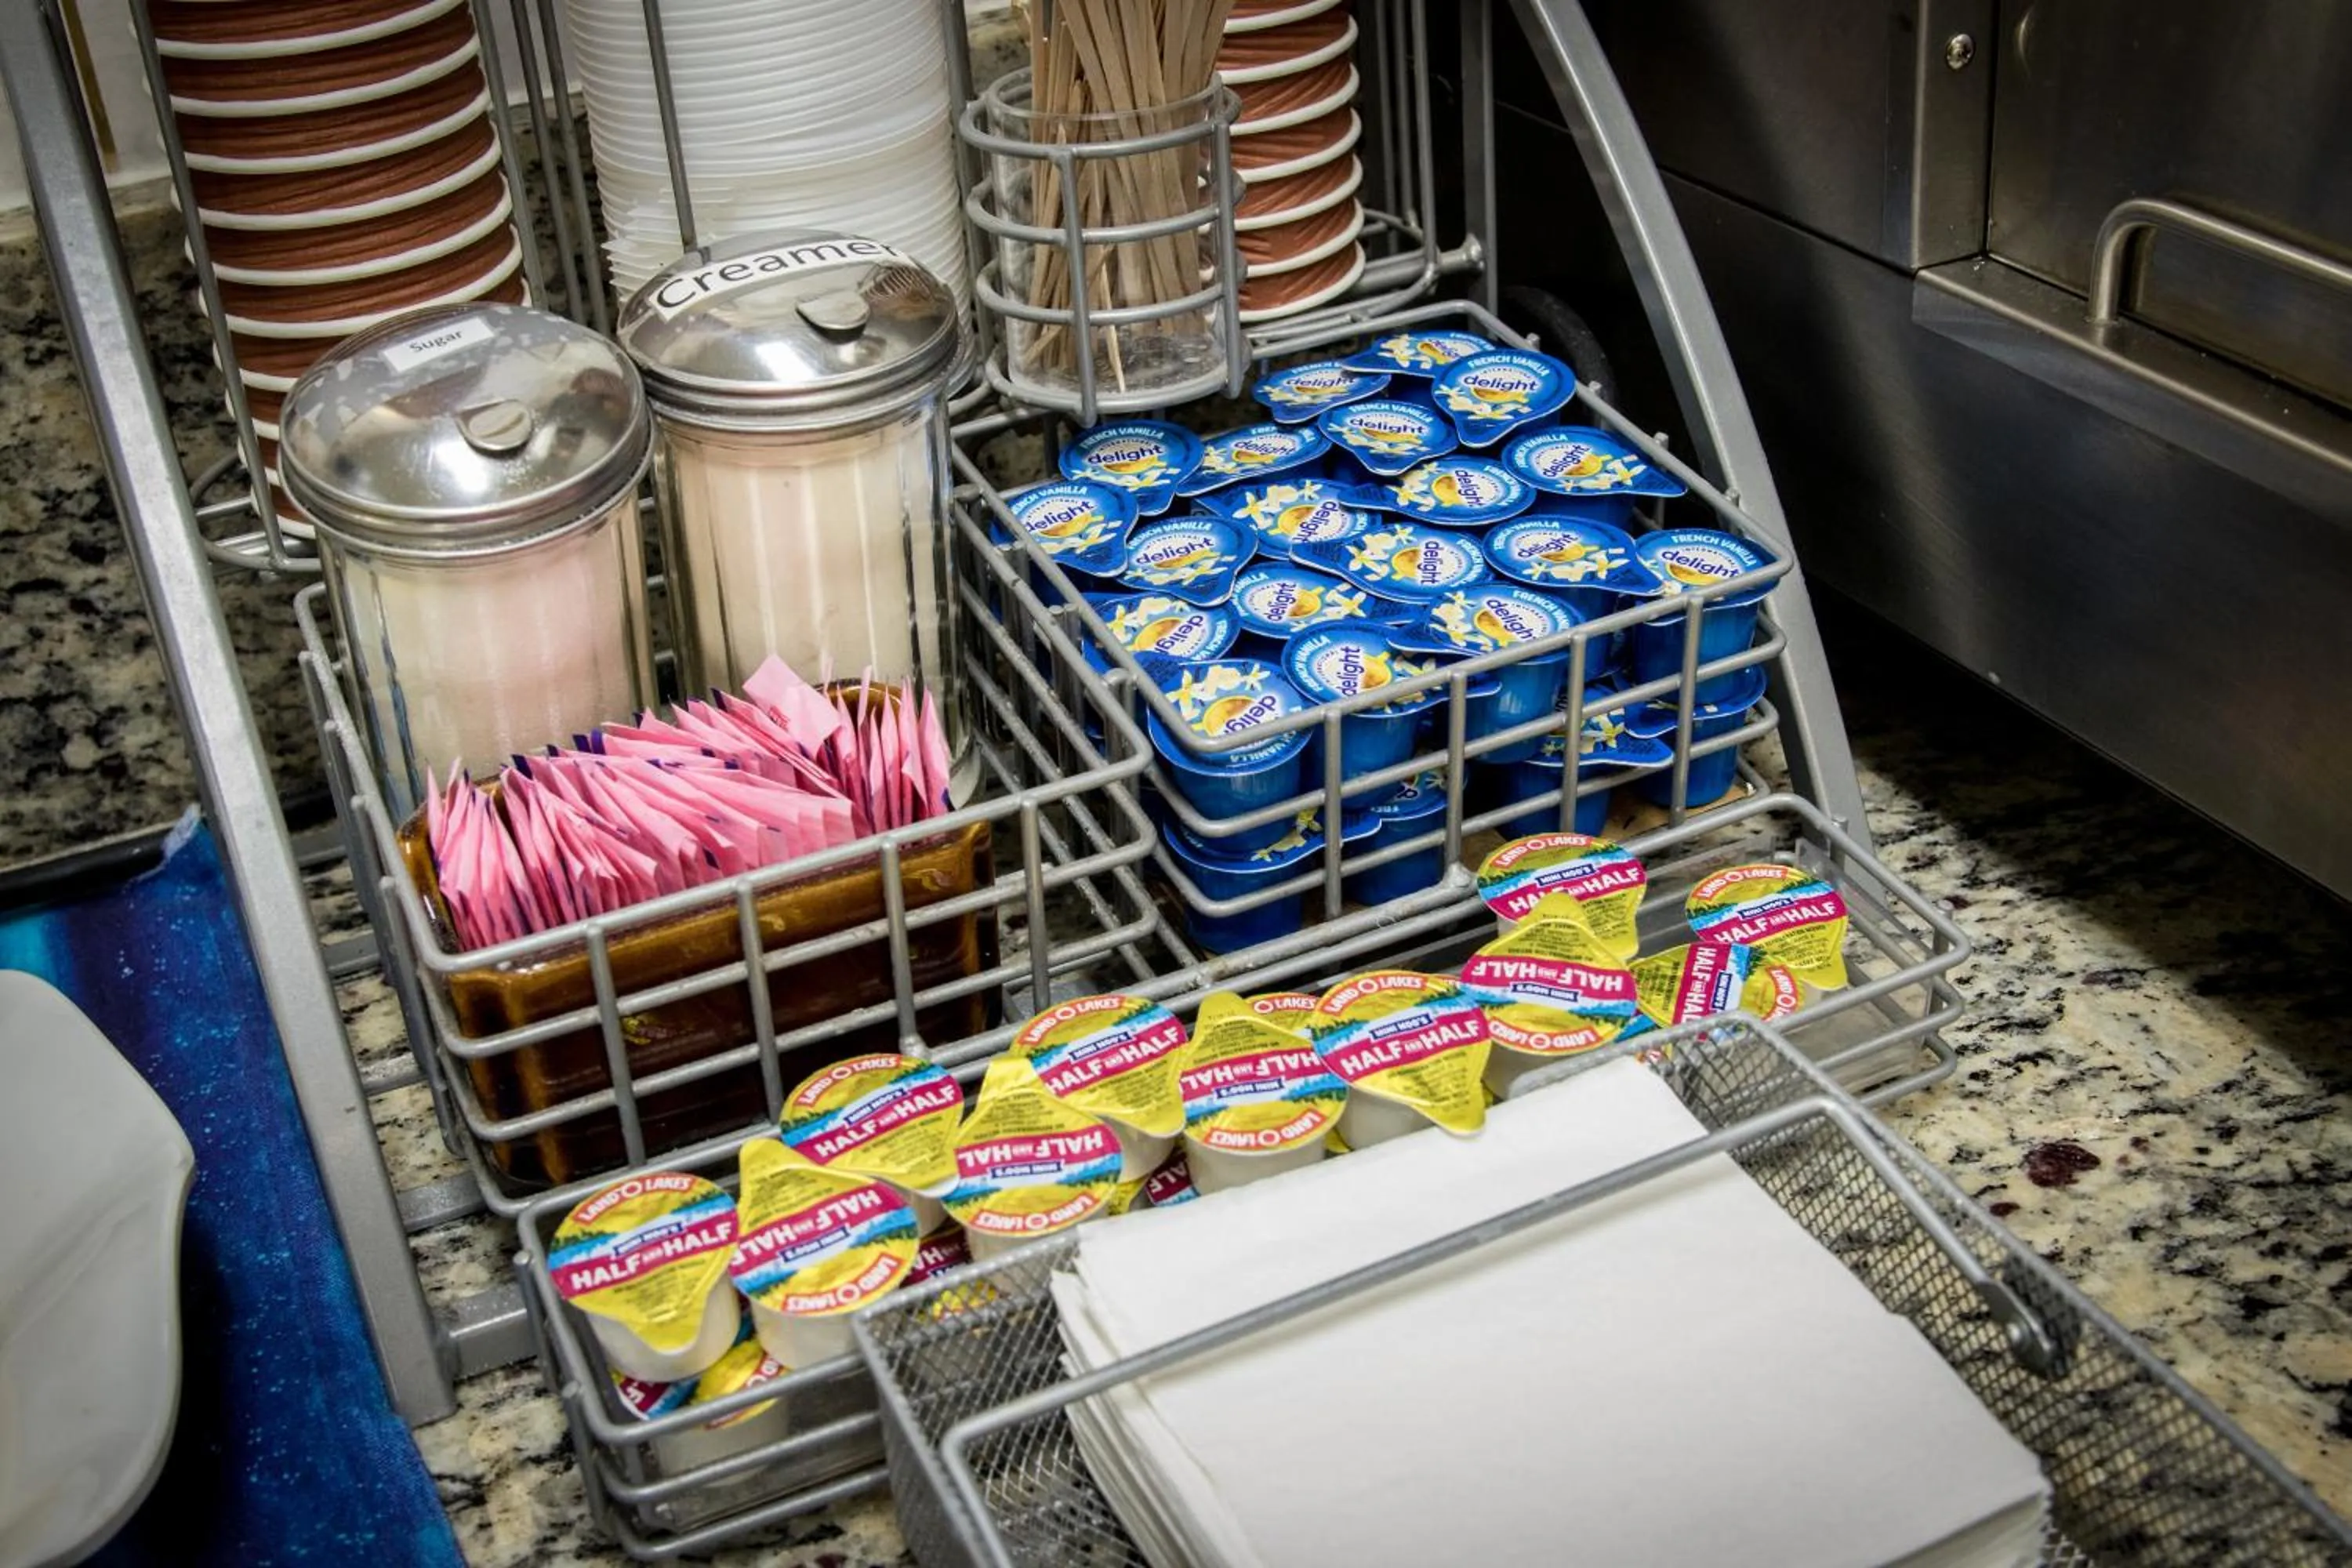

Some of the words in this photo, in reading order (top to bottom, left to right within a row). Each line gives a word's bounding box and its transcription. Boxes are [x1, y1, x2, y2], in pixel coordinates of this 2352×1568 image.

[657, 237, 899, 308] Creamer
[409, 328, 463, 354] Sugar
[1468, 355, 1510, 367] FRENCH
[1512, 356, 1551, 376] VANILLA
[1287, 376, 1356, 388] delight
[1463, 375, 1538, 391] delight
[1349, 403, 1390, 412] FRENCH
[1391, 404, 1434, 423] VANILLA
[1349, 417, 1425, 434] delight
[1080, 429, 1116, 448] FRENCH
[1118, 427, 1165, 440] VANILLA
[1087, 444, 1163, 465] delight
[1543, 444, 1591, 478] delight
[1040, 486, 1088, 501] VANILLA
[1454, 470, 1484, 508] delight
[1127, 528, 1162, 550] FRENCH
[1163, 521, 1213, 534] VANILLA
[1291, 501, 1338, 543] delight
[1136, 537, 1214, 564] delight
[1518, 533, 1578, 559] delight
[1671, 534, 1719, 545] FRENCH
[1417, 541, 1441, 585] delight
[1661, 549, 1740, 579] delight
[1267, 583, 1297, 622] delight
[1512, 590, 1558, 615] FRENCH
[1486, 599, 1537, 640] deligh
[1153, 615, 1204, 654] delig
[1337, 647, 1364, 696] delight
[1225, 695, 1276, 735] delig
[1495, 847, 1528, 867] LAND
[1526, 839, 1547, 851] O
[1547, 836, 1588, 848] LAKES
[1541, 873, 1562, 884] MINI
[1563, 865, 1592, 878] MOO'S
[1697, 878, 1726, 899] LAND
[1726, 870, 1745, 883] O
[1744, 869, 1784, 879] LAKES
[1508, 887, 1566, 913] HA
[1583, 867, 1640, 894] HALF
[1714, 917, 1770, 943] HALF
[1784, 901, 1836, 924] HALF
[1471, 960, 1537, 981] HALF
[1690, 946, 1719, 982] HALF
[1556, 967, 1624, 993] HALF
[1771, 969, 1794, 995] LAND
[1254, 1000, 1275, 1014] O
[1274, 997, 1317, 1011] LAKES
[1321, 989, 1360, 1014] LAND
[1357, 978, 1379, 993] O
[1379, 976, 1425, 989] LAKES
[1680, 992, 1708, 1024] HAL
[1775, 993, 1798, 1008] O
[1025, 1017, 1057, 1043] LAND
[1054, 1006, 1077, 1021] O
[1076, 997, 1121, 1011] LAKES
[1489, 1021, 1531, 1044] LAKES
[1339, 1040, 1404, 1076] HALF
[1420, 1020, 1482, 1051] HALF
[1529, 1033, 1553, 1050] O
[1552, 1029, 1597, 1047] LAND
[1046, 1058, 1105, 1095] HALF
[1119, 1025, 1181, 1063] HALF
[1255, 1051, 1323, 1076] HALF
[797, 1077, 834, 1105] LAND
[831, 1066, 852, 1080] O
[852, 1056, 898, 1072] LAKES
[1180, 1065, 1236, 1091] HAL
[815, 1120, 878, 1158] HALF
[895, 1083, 956, 1119] HALF
[1280, 1110, 1322, 1139] LAND
[1034, 1131, 1104, 1159] HALF
[1209, 1130, 1257, 1147] LAKES
[1258, 1129, 1281, 1146] O
[958, 1144, 1014, 1167] HAL
[1148, 1160, 1191, 1193] ALF
[578, 1191, 622, 1222] LAND
[619, 1181, 644, 1198] O
[644, 1177, 692, 1192] LAKES
[815, 1189, 883, 1231] HALF
[1050, 1194, 1093, 1220] LAND
[975, 1212, 1025, 1231] LAKES
[1025, 1213, 1050, 1230] O
[570, 1254, 642, 1290] HALF
[660, 1222, 732, 1258] HALF
[731, 1224, 797, 1267] HALF
[858, 1256, 898, 1295] LAND
[786, 1294, 837, 1313] LAKES
[836, 1283, 861, 1304] O
